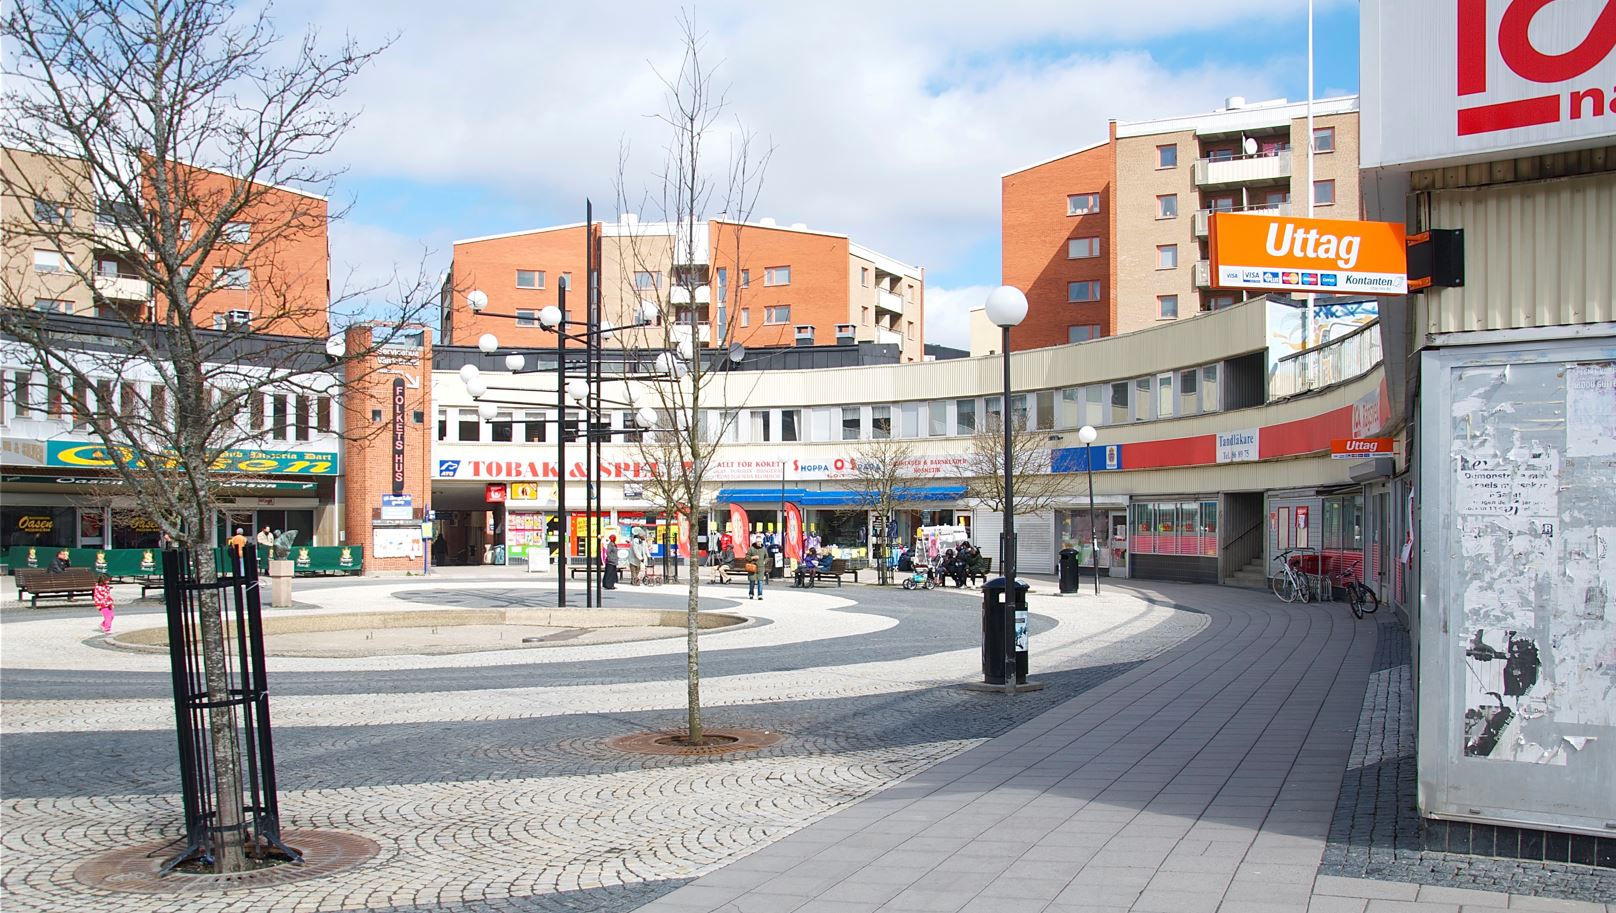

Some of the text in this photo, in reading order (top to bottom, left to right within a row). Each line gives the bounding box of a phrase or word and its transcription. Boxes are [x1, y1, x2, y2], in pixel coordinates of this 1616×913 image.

[1265, 222, 1361, 269] Uttag
[1345, 274, 1393, 287] Kontanten
[395, 387, 404, 482] FOLKETS HUS
[1218, 433, 1254, 448] Tandläkare
[1345, 440, 1379, 452] Uttag
[468, 461, 559, 477] TOBAK
[569, 461, 588, 478] &
[793, 459, 829, 472] SHOPPA
[833, 458, 845, 471] O
[18, 516, 55, 529] Oasen
